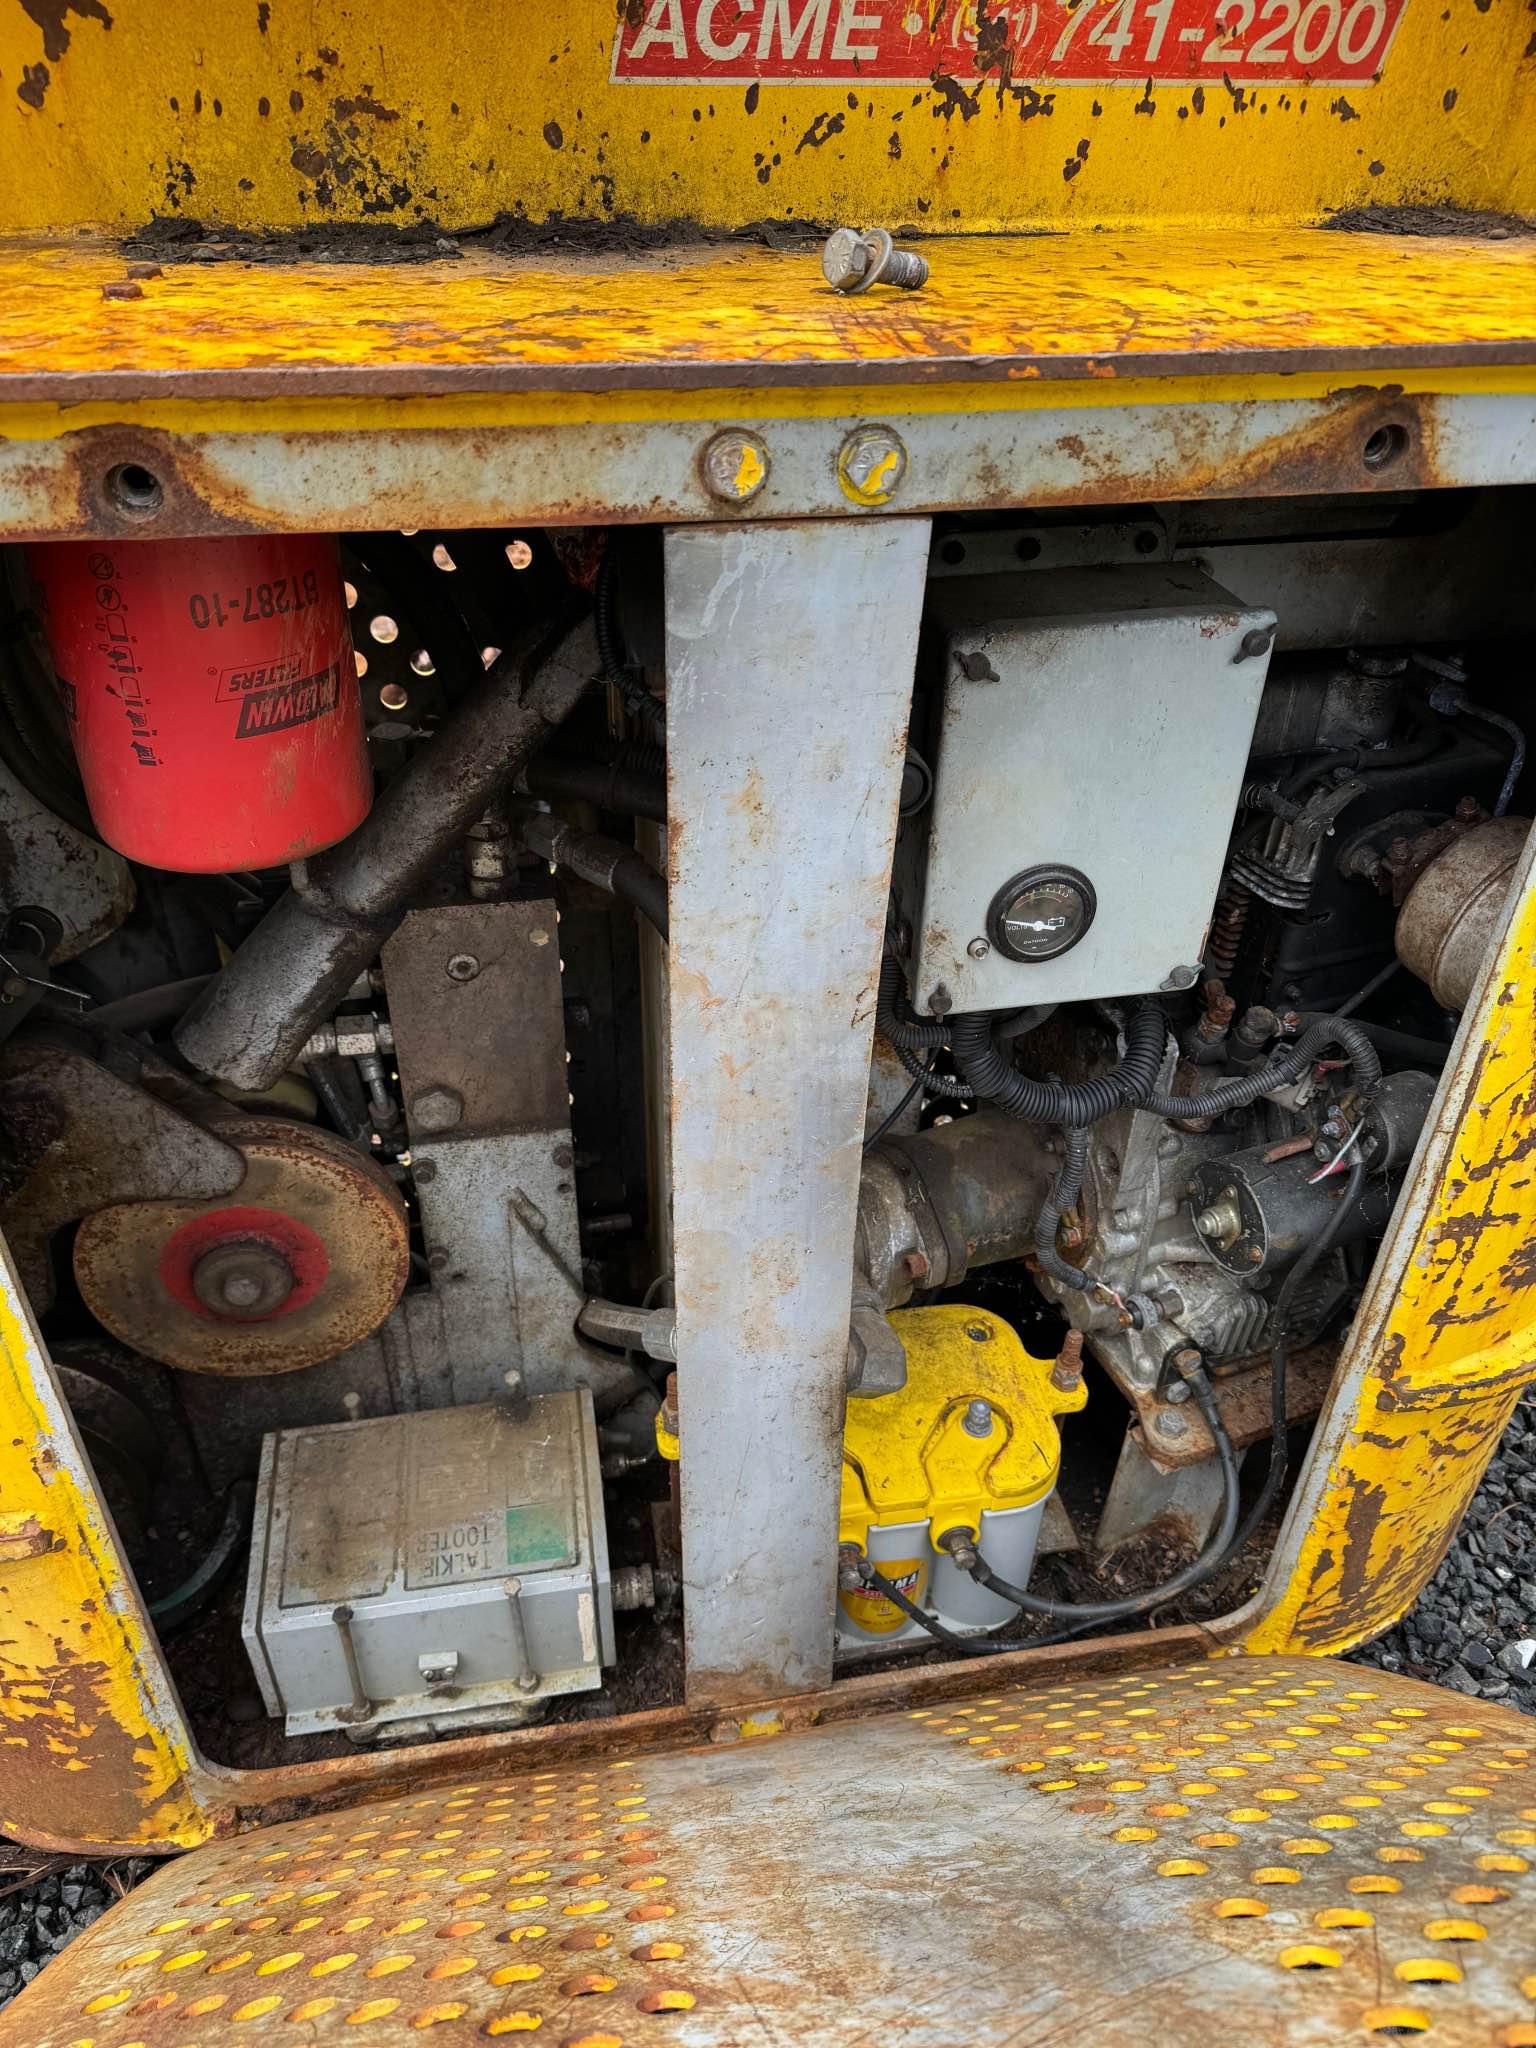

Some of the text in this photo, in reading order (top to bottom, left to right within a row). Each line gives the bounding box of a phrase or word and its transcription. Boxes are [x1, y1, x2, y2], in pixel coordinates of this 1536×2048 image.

[624, 0, 882, 61] ACME
[1050, 0, 1387, 64] 741-2200
[190, 569, 319, 629] BT287-10
[228, 658, 302, 693] FILTERS
[416, 1524, 492, 1554] TOOTER
[422, 1551, 492, 1579] TALKIE
